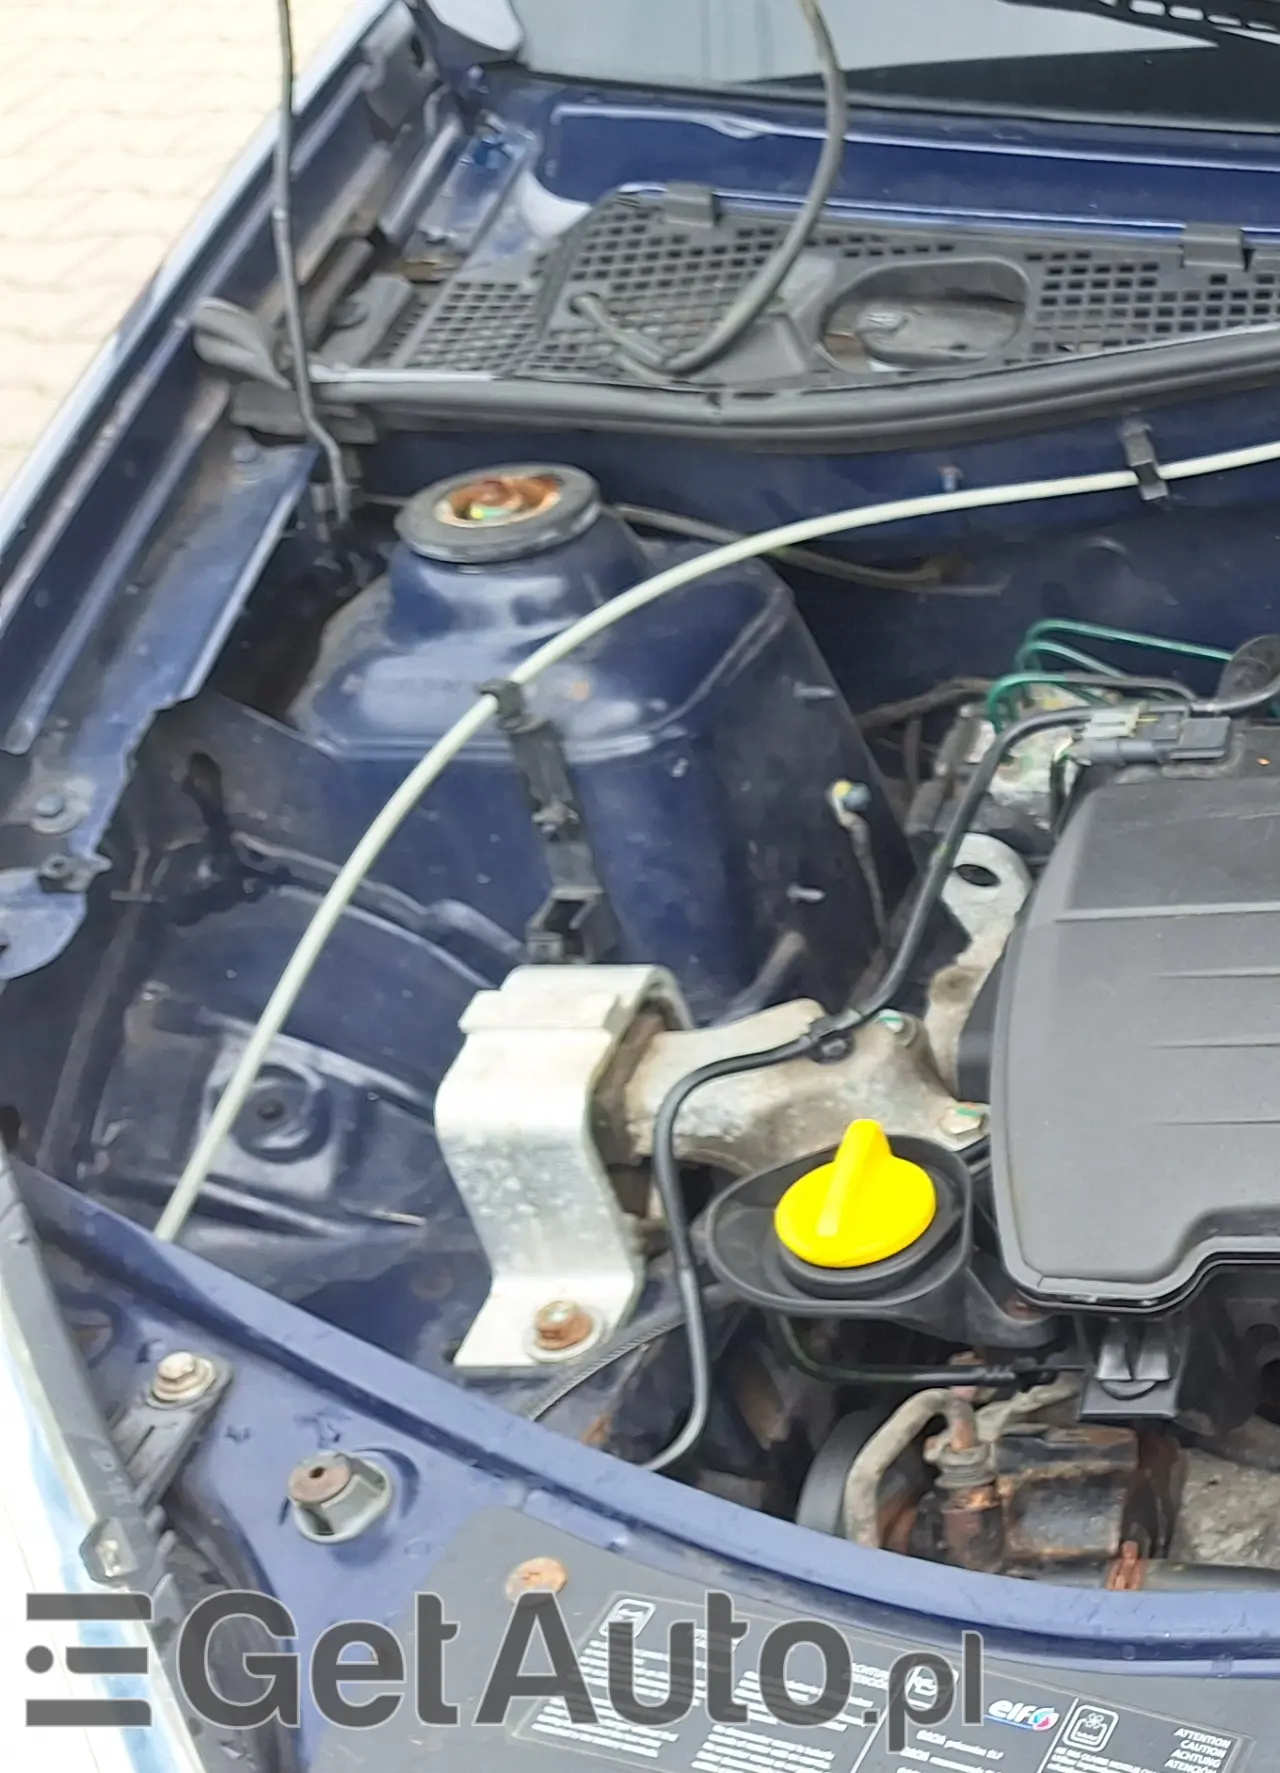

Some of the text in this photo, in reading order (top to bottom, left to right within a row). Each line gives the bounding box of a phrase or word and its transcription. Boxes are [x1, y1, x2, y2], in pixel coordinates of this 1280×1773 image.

[1174, 1728, 1232, 1749] ATTENTION
[1170, 1749, 1222, 1768] ACHTUNG
[1180, 1740, 1227, 1758] CAUTION
